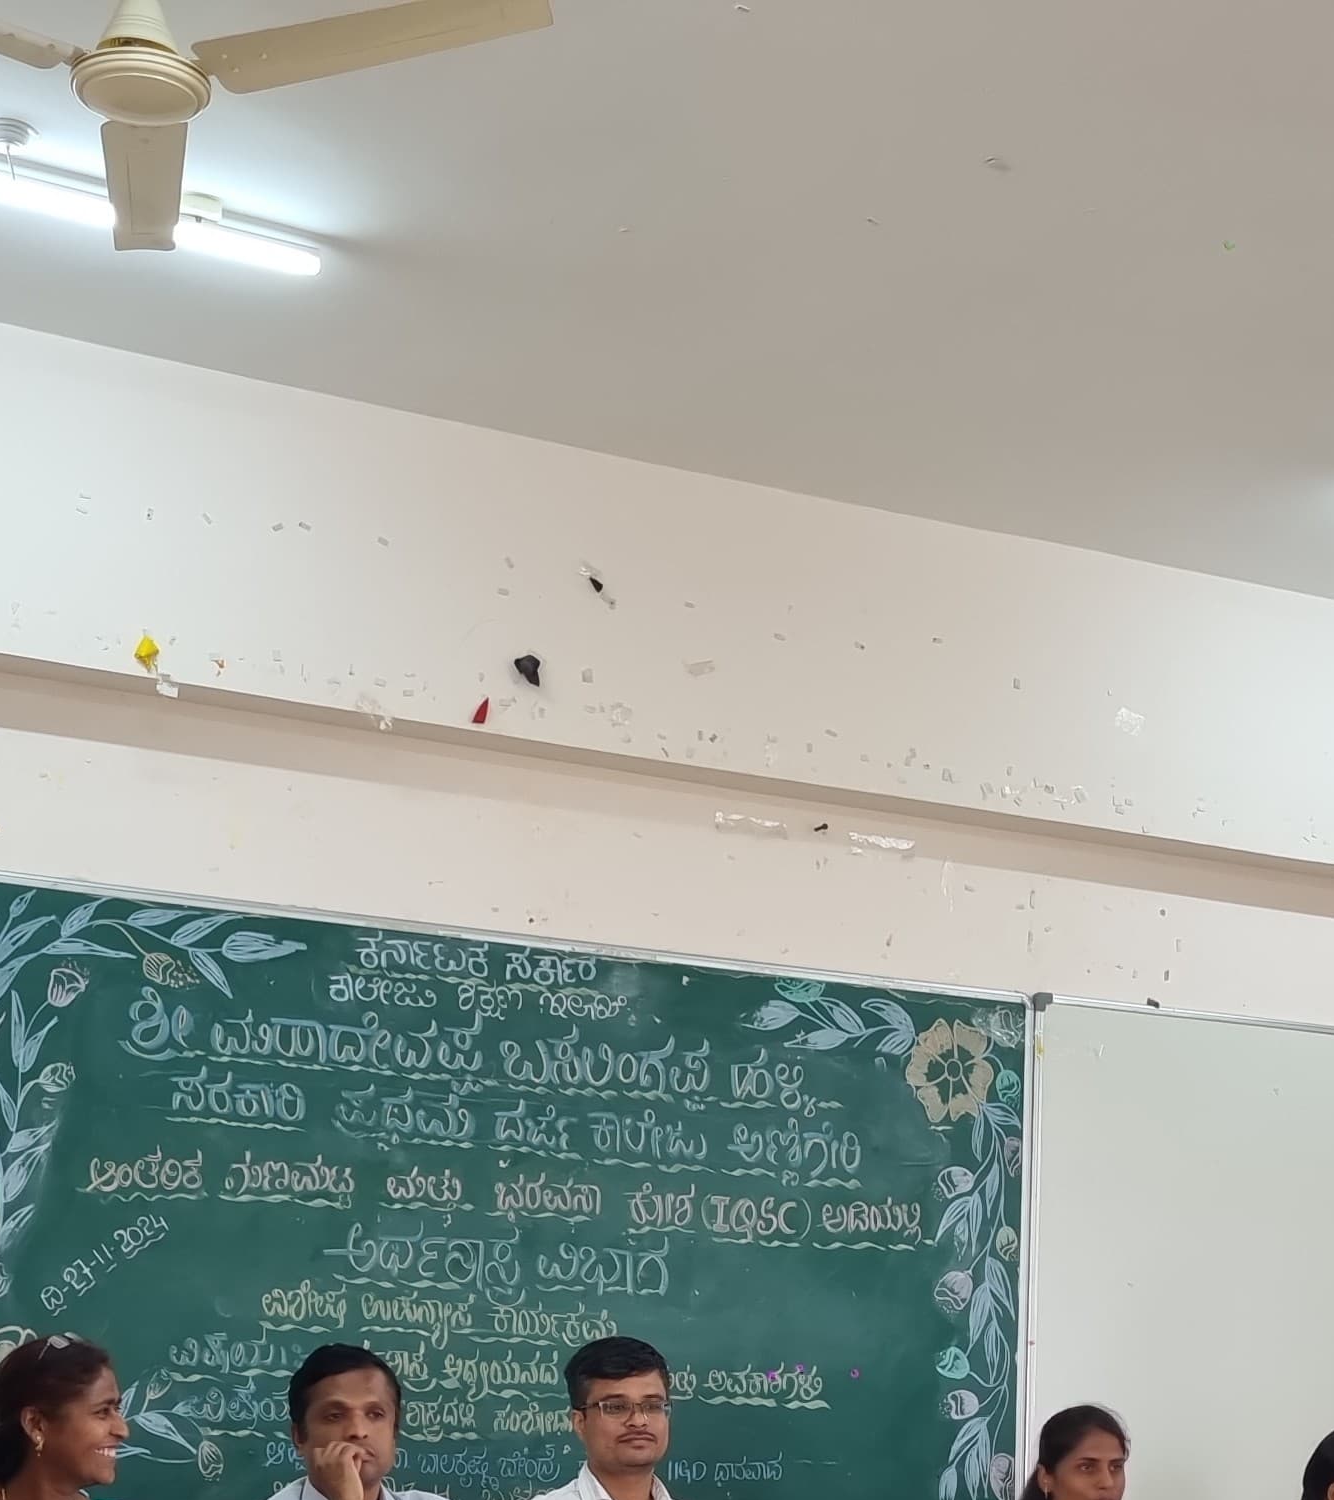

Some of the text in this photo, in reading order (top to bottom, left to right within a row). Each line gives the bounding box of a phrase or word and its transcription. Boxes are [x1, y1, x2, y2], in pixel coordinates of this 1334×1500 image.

[355, 931, 598, 986] ಕರ್ನಾಟಕ ಸರ್ಕಾರ
[118, 987, 195, 1061] ಶ್ರೀ
[328, 972, 438, 1007] ಕಾಲೇಜು
[457, 979, 523, 1021] ಶಿಕ್ಷಣ
[169, 1064, 306, 1121] ಸರಕಾರಿ
[587, 1109, 708, 1161] ಕಾಲೇಜು
[536, 1236, 669, 1297] ವಿಭಾಗ
[262, 1279, 348, 1329] ವಿಶೇಷ
